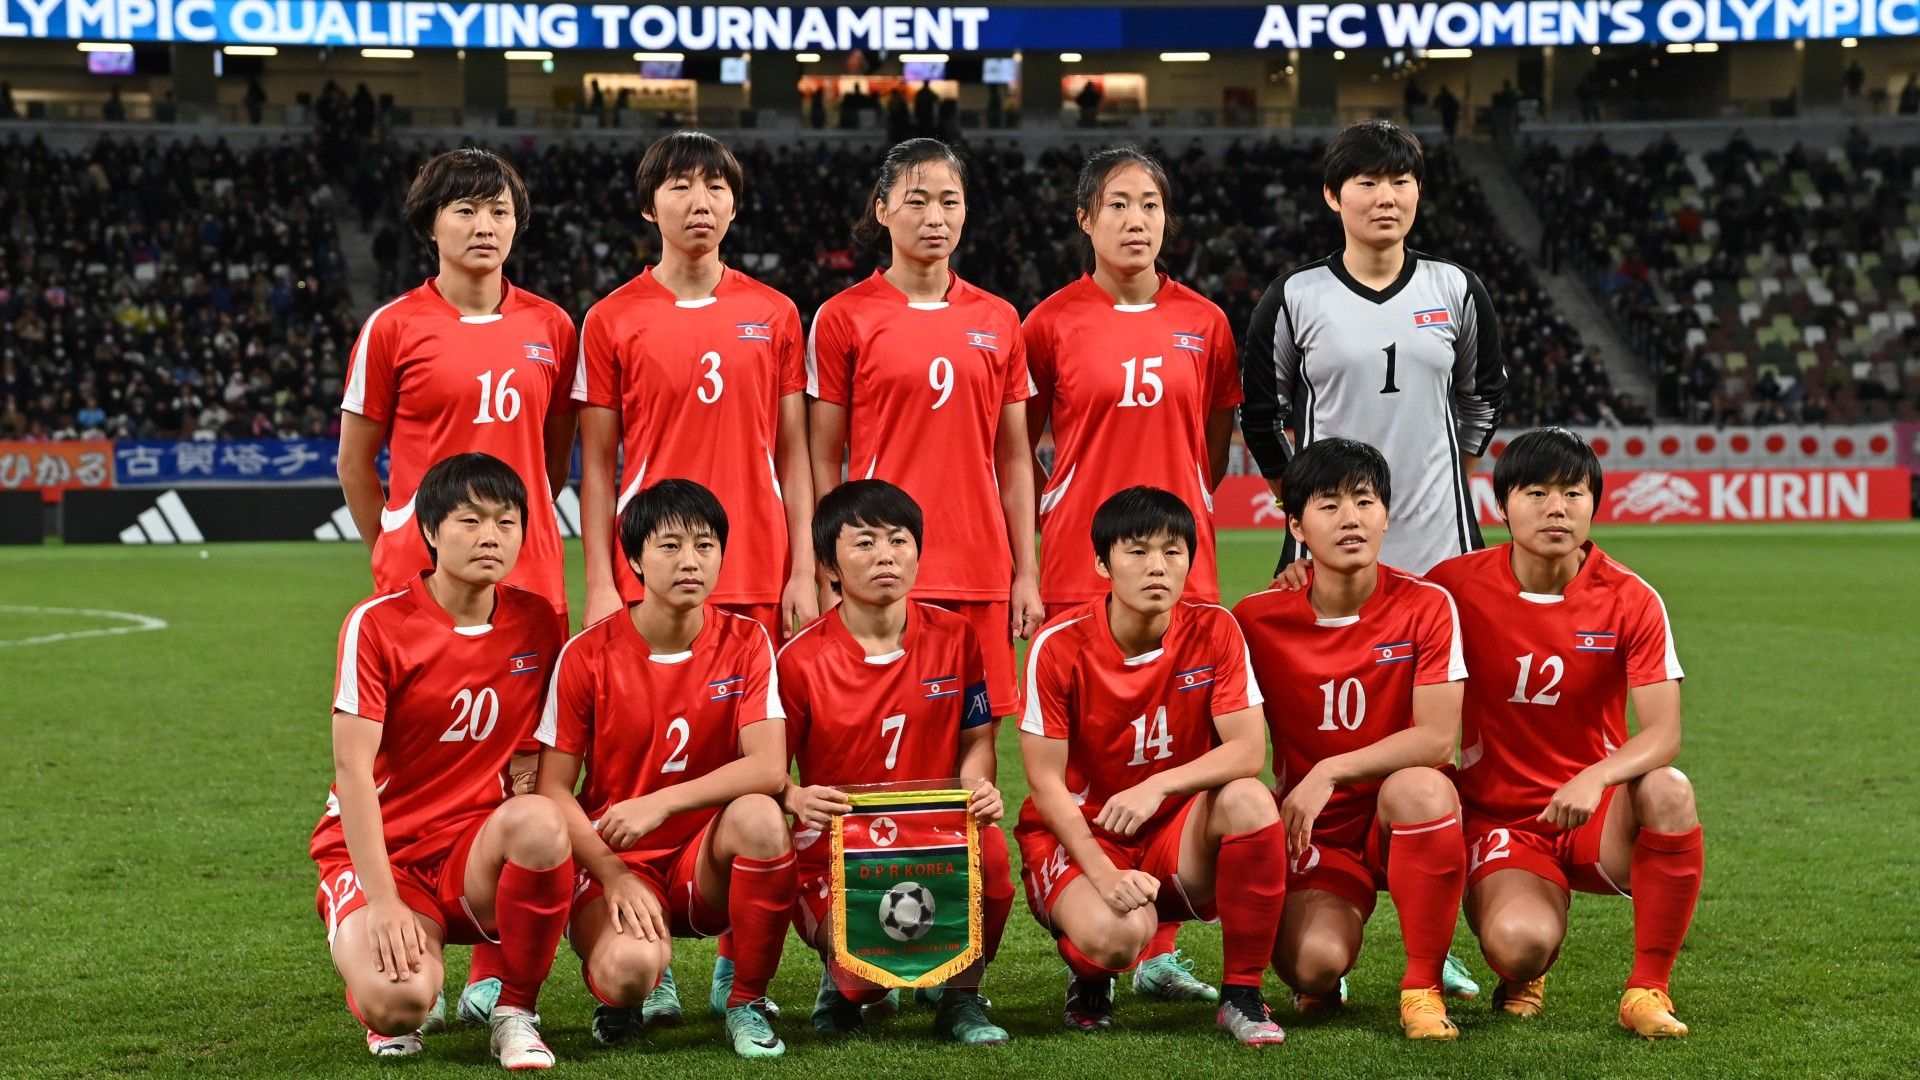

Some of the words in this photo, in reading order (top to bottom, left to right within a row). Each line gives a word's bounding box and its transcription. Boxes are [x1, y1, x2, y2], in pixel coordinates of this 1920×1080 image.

[228, 1, 579, 48] QUALIFYING
[592, 5, 989, 51] TOURNAMENT
[1254, 4, 1367, 49] AFC
[1378, 0, 1645, 47] WOMEN'S
[1656, 0, 1920, 43] OLYMPIC
[697, 351, 724, 404] 3
[928, 356, 955, 410] 9
[1116, 355, 1164, 408] 15
[1379, 341, 1401, 394] 1
[472, 367, 521, 424] 16
[117, 442, 341, 475] 古賀塔子
[1708, 471, 1869, 519] KIRIN
[1317, 677, 1366, 731] 10
[1507, 652, 1565, 706] 12
[439, 687, 499, 742] 20
[881, 713, 906, 770] 7
[1127, 705, 1173, 766] 14
[660, 717, 690, 774] 2
[904, 862, 955, 878] KOREA
[1040, 843, 1070, 901] 14
